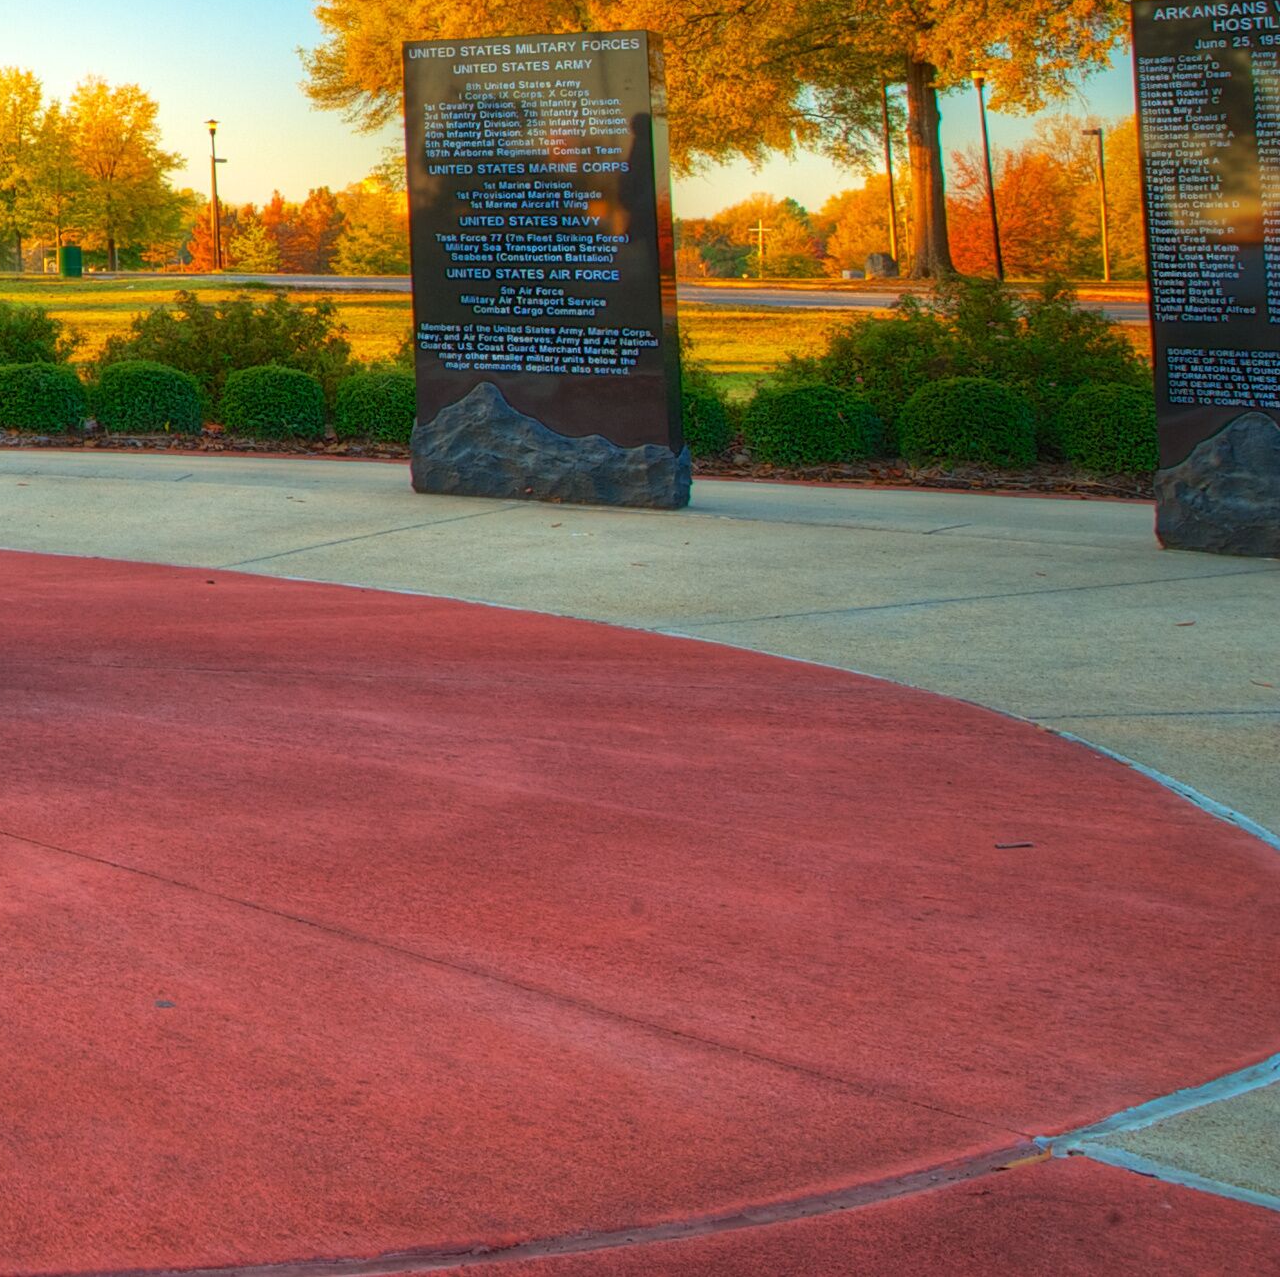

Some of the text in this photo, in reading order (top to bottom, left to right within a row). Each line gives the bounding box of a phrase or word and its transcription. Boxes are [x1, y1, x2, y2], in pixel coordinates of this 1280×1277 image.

[1153, 2, 1268, 20] ARKANSANS
[1212, 17, 1280, 31] HOSTIL
[409, 39, 640, 58] UNITED STATES MILITARY FORCES
[1195, 38, 1227, 49] June
[453, 60, 593, 74] UNITED STATES ARMY
[1252, 59, 1278, 68] Army
[466, 80, 581, 90] 8th United States Army
[425, 139, 439, 148] 5th
[442, 139, 494, 149] Regimental
[497, 139, 534, 147] Combat
[425, 146, 622, 158] 187th Airborne Regimental Combat Team
[428, 162, 630, 175] UNITED STATES MARINE CORPS
[483, 181, 572, 189] 1st Marine Division
[456, 191, 602, 201] 1st Provisional Marine Brigade
[470, 200, 589, 210] 1st Marine Aircraft Wing
[459, 216, 600, 226] UNITED STATES NAVY
[435, 233, 629, 246] Task Force 77 (7th Fleet Striking Force)
[445, 243, 618, 254] Military Sea Transportation Service
[451, 254, 614, 264] Seabees (Construction Battalion)
[446, 268, 619, 280] UNITED STATES AIR FORCE
[500, 287, 564, 296] 5th Air Force
[461, 296, 606, 307] Military Air Transport Service
[473, 306, 595, 317] Combat Cargo Command
[421, 323, 460, 332] Members
[463, 324, 472, 333] of
[476, 325, 490, 333] the
[493, 325, 522, 334] United
[524, 326, 555, 334] States
[587, 327, 619, 336] Marine
[443, 333, 460, 342] and
[463, 334, 475, 342] Air
[478, 334, 504, 343] Force
[555, 336, 580, 346] Army
[583, 337, 600, 345] and
[603, 337, 616, 346] Air
[619, 338, 658, 347] National
[438, 352, 636, 365] many other smaller military units below the
[445, 361, 469, 371] major
[473, 362, 522, 371] commands
[571, 365, 591, 374] also
